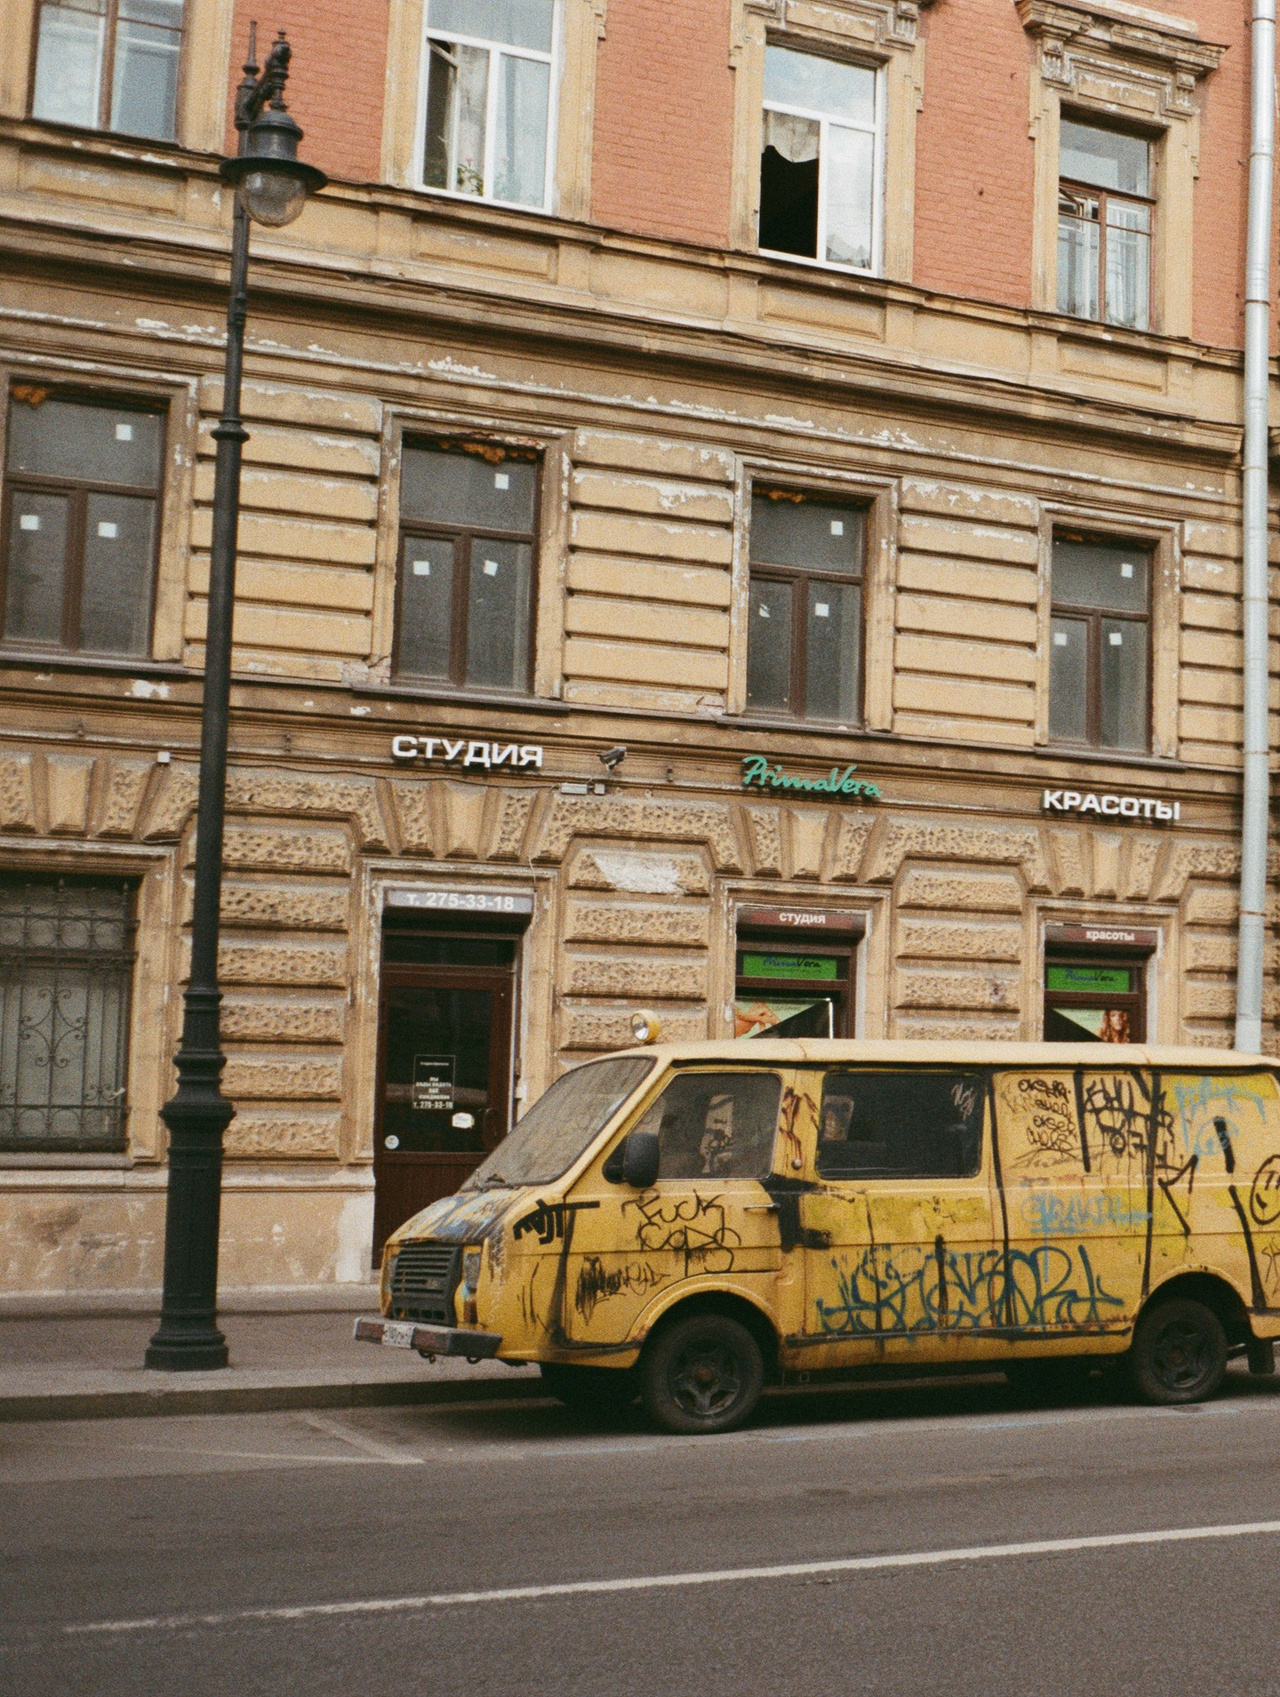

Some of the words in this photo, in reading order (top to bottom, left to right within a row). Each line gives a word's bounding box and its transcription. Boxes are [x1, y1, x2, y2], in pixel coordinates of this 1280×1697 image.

[392, 735, 543, 768] СТУДИЯ
[742, 755, 883, 797] PrimaVera
[1043, 789, 1181, 820] КРАСОТЫ
[426, 891, 515, 911] 275-33-18
[779, 912, 827, 925] студия
[1085, 930, 1135, 942] красоты
